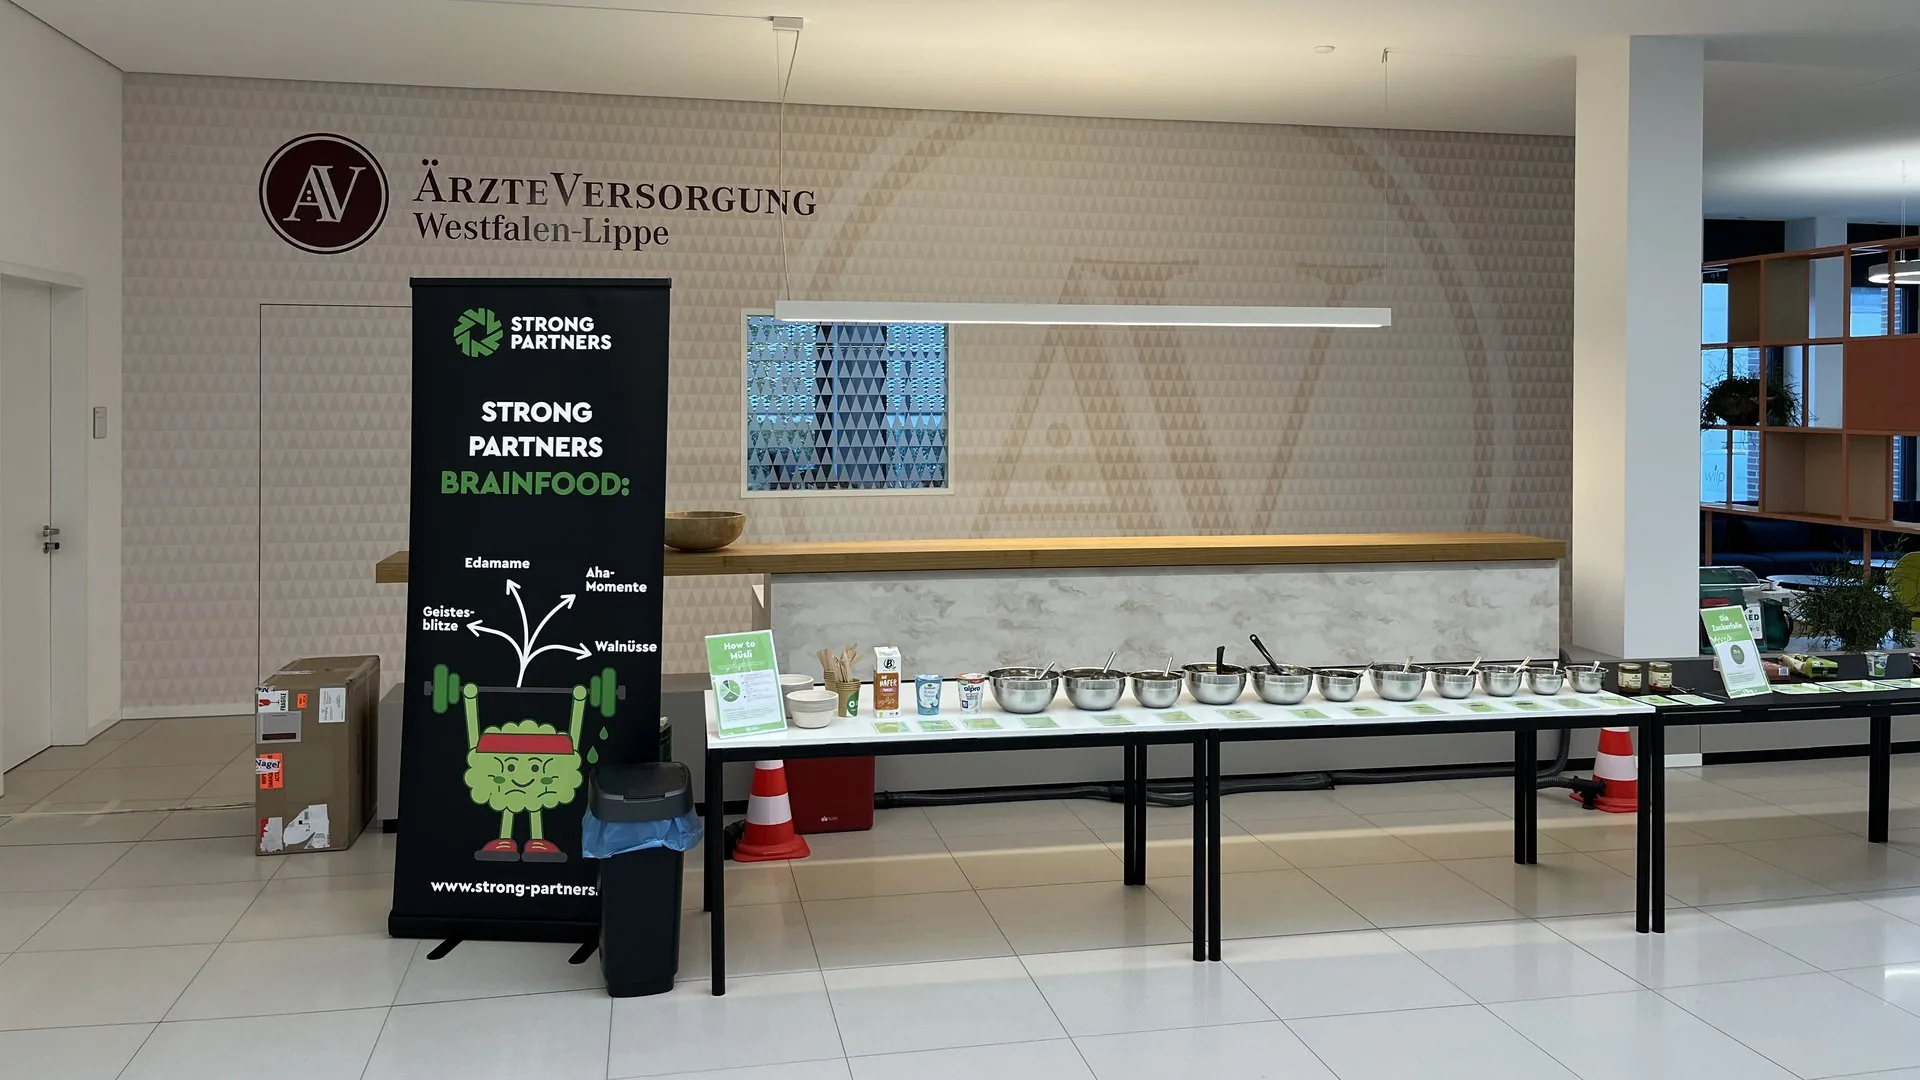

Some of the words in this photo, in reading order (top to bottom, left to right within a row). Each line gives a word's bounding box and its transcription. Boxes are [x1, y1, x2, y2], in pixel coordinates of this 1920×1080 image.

[283, 165, 367, 223] AV
[413, 212, 670, 251] Westfalen-Lippe
[511, 316, 595, 332] STRONG
[510, 334, 612, 350] PARTNERS
[481, 401, 593, 423] STRONG
[469, 435, 603, 458] PARTNERS
[441, 470, 630, 496] BRAINFOOD:
[464, 557, 530, 569] Edamame
[585, 566, 615, 579] Aha-
[585, 581, 648, 593] Momente
[423, 606, 475, 619] Geistes-
[423, 619, 458, 632] blitze
[595, 640, 658, 653] Walnüsse
[723, 641, 744, 651] How
[745, 640, 756, 648] to
[729, 650, 753, 661] Müsli
[963, 685, 981, 693] alpro
